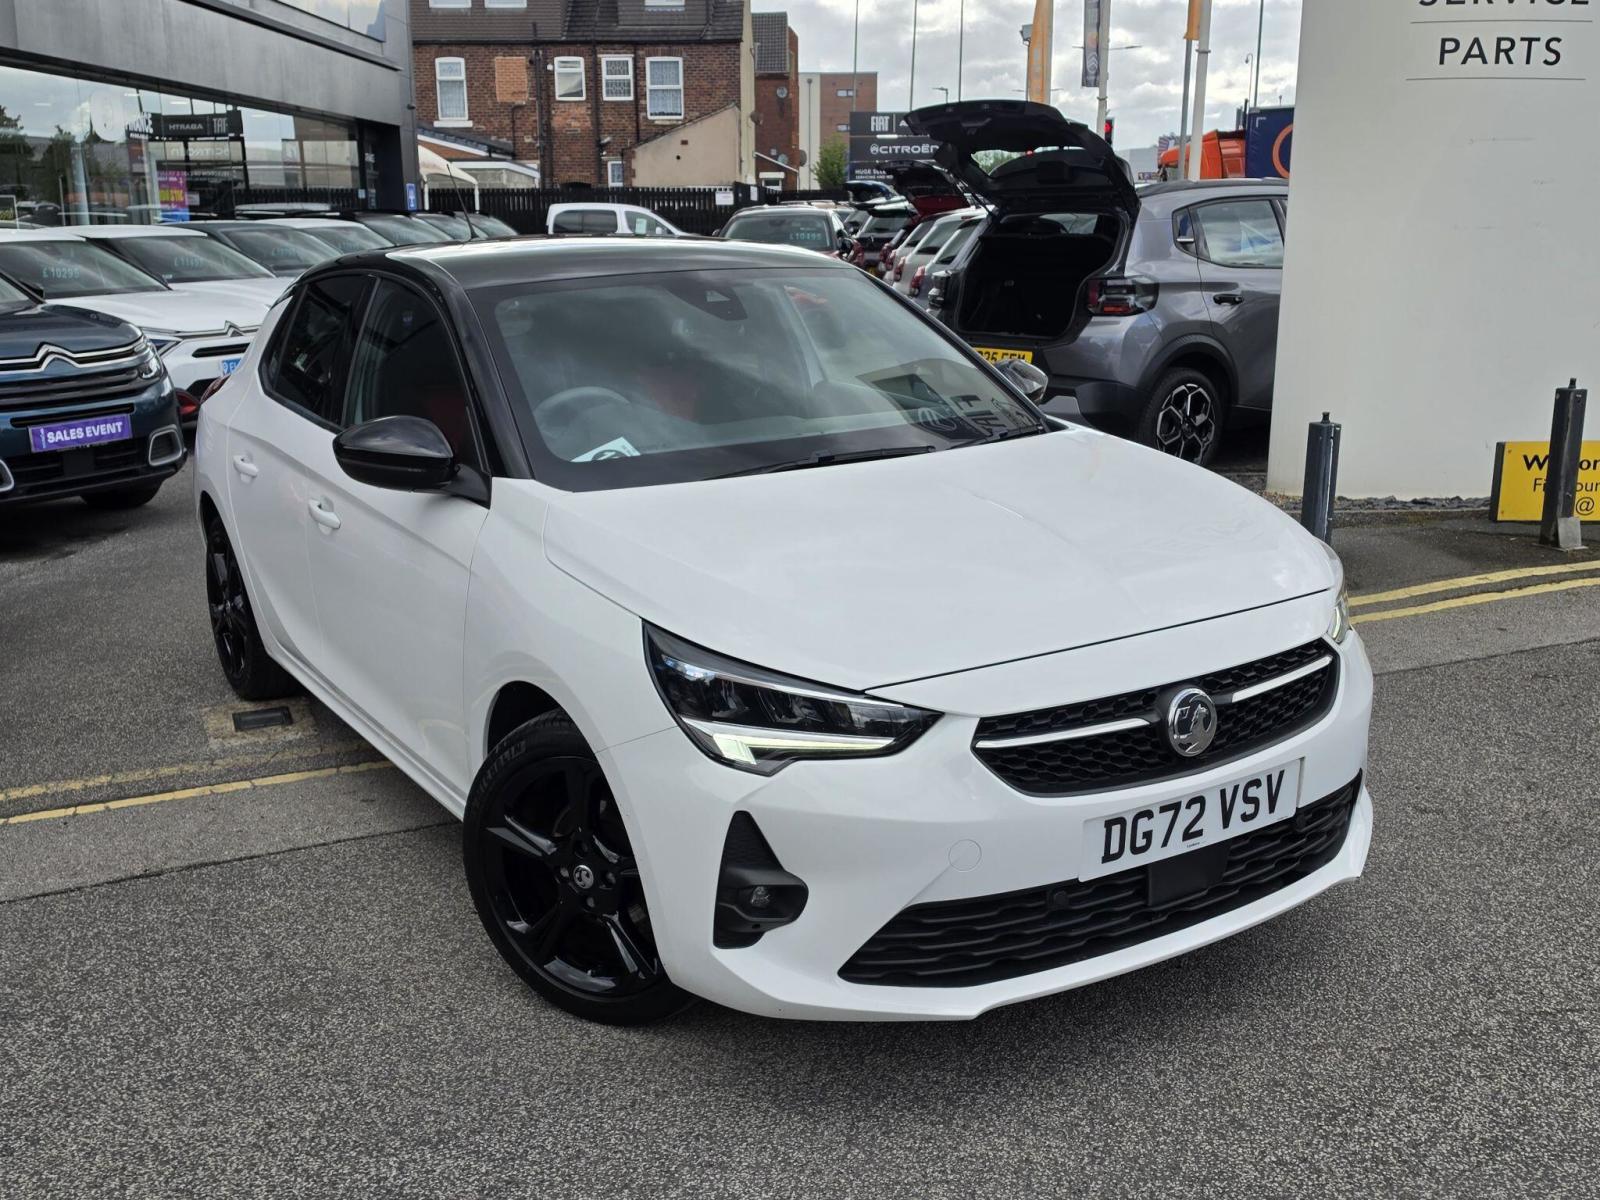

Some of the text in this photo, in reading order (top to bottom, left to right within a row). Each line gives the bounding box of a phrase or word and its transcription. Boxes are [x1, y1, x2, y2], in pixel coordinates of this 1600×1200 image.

[1439, 36, 1563, 66] PARTS
[870, 115, 890, 132] FIAT
[46, 427, 84, 444] SALES
[85, 421, 123, 438] EVENT
[1101, 769, 1285, 864] DG72 VSV
